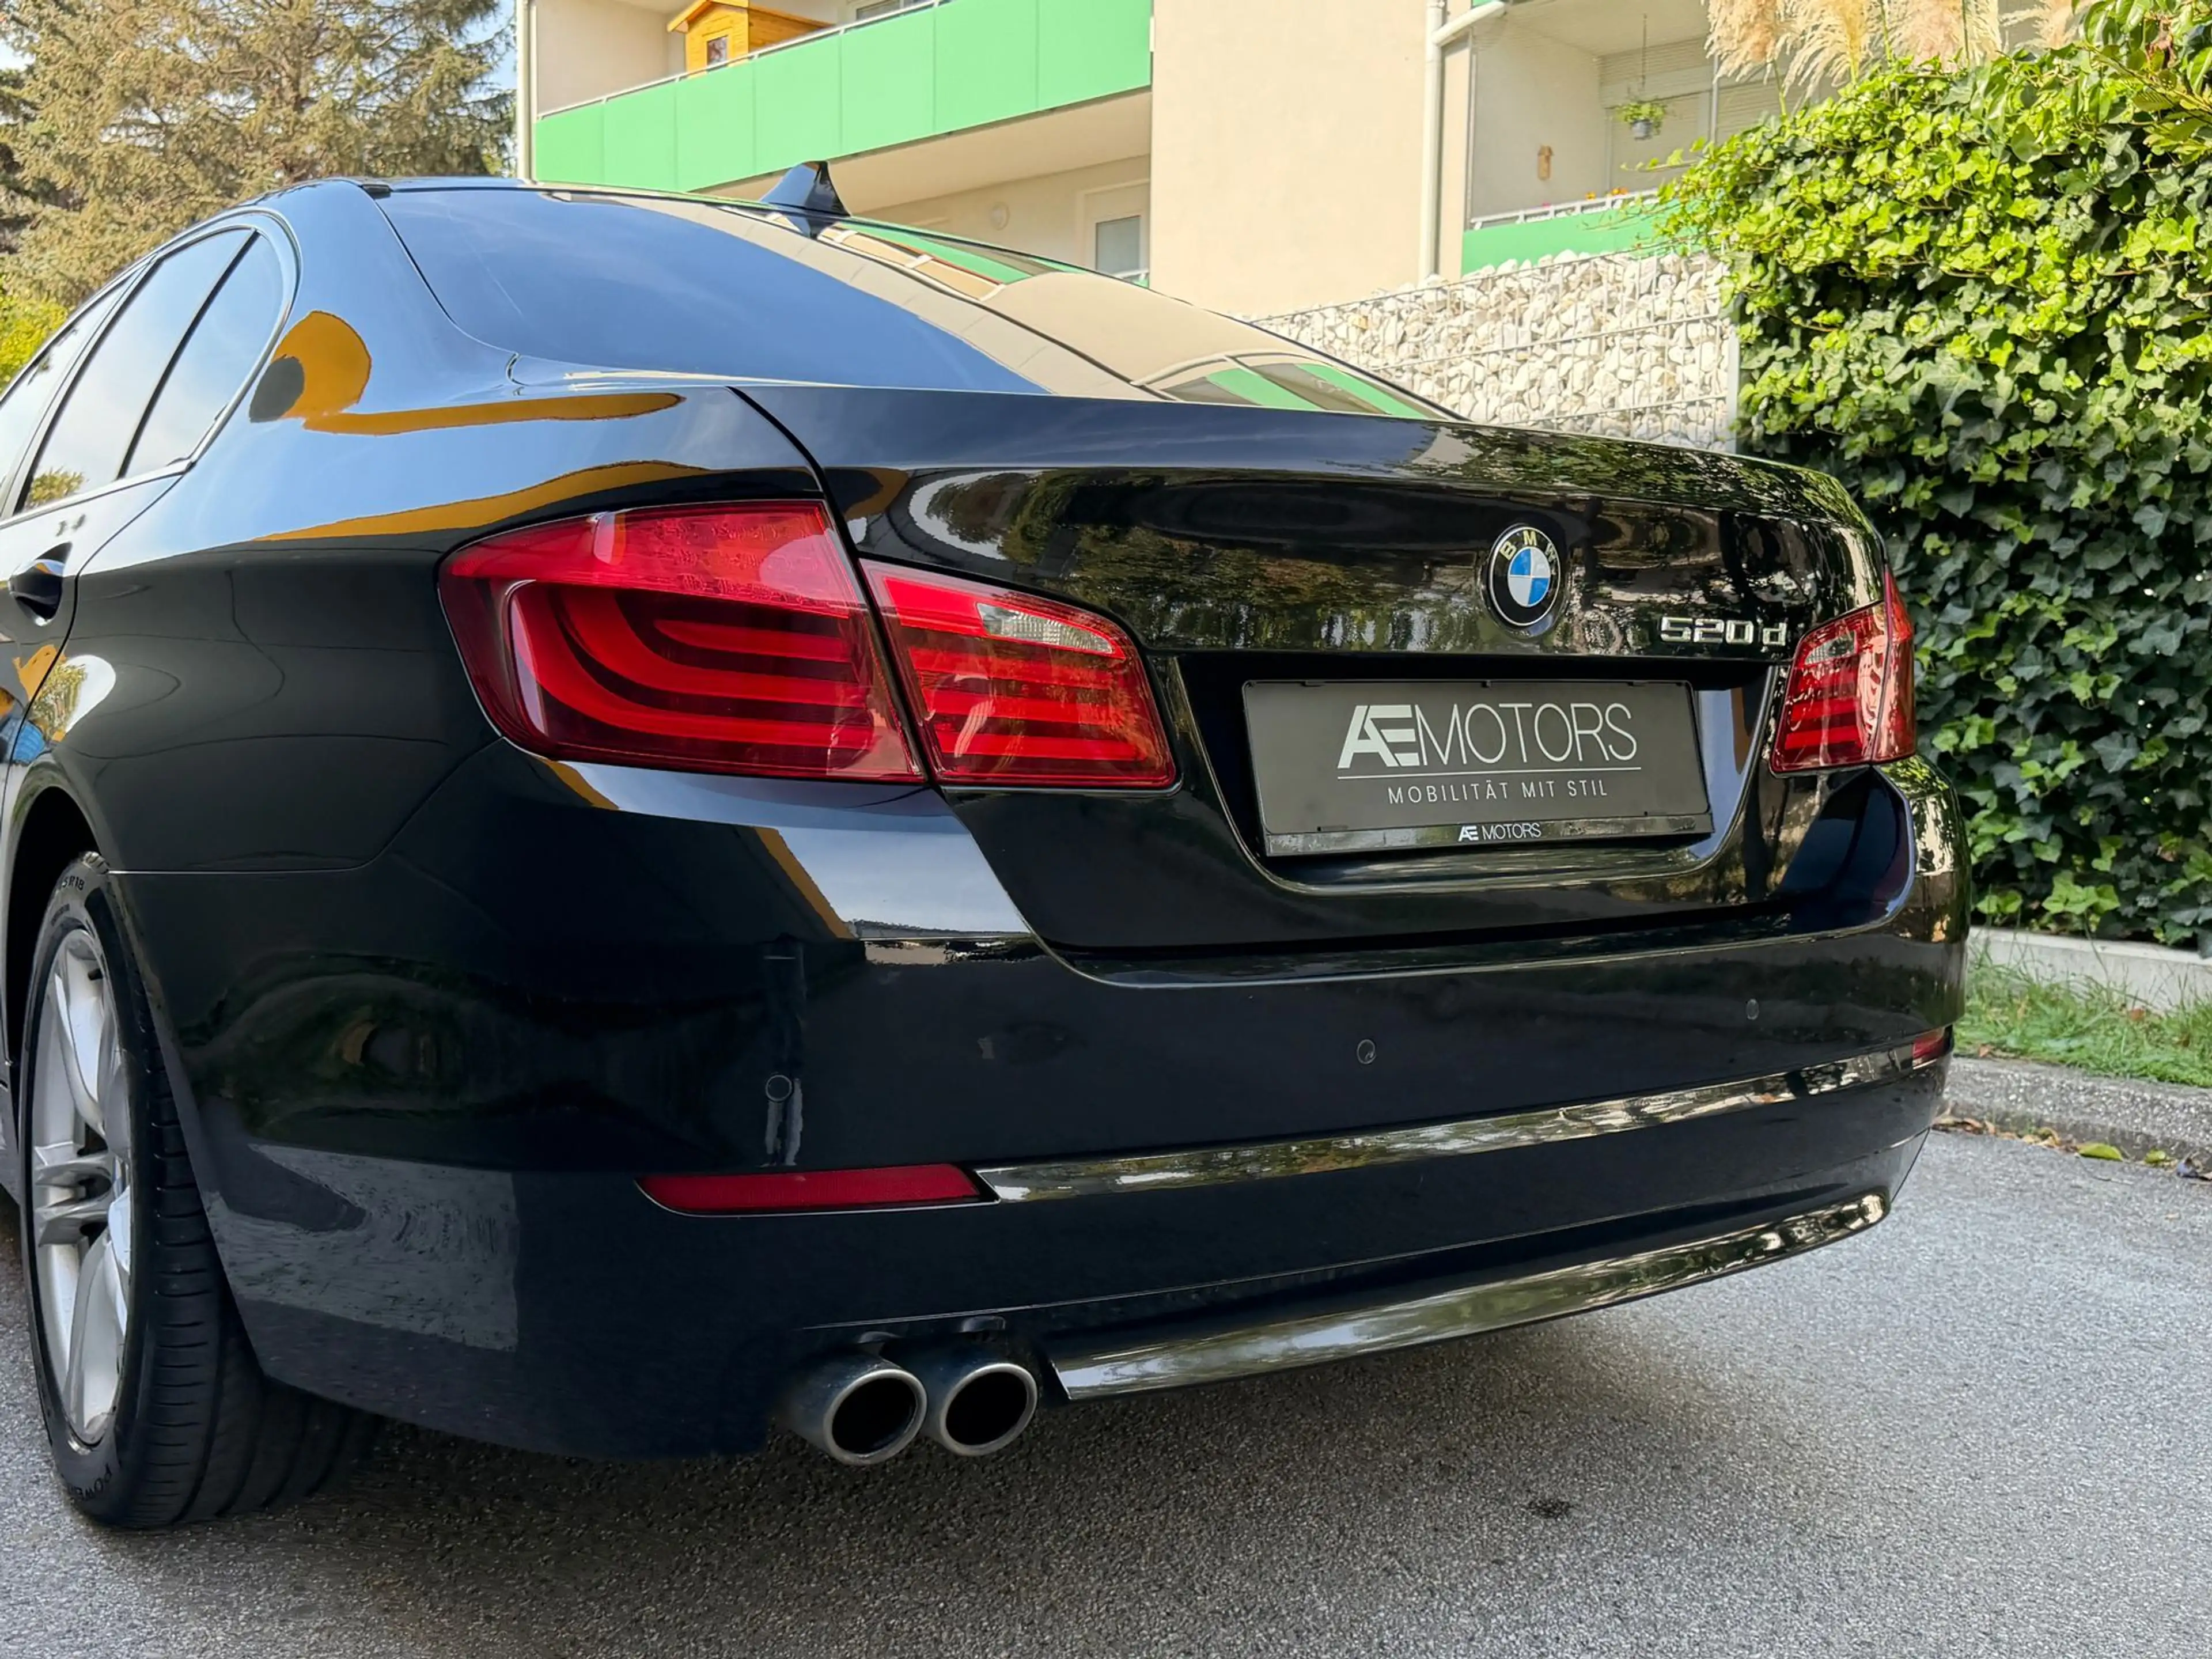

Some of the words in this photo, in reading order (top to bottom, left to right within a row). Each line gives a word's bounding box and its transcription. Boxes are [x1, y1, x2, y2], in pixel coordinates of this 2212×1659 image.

[1499, 531, 1557, 575] BMW
[1388, 779, 1508, 804] MOBILITÄT
[1521, 781, 1555, 798] MIT
[1567, 779, 1608, 797] STIL
[1481, 822, 1541, 841] MOTORS
